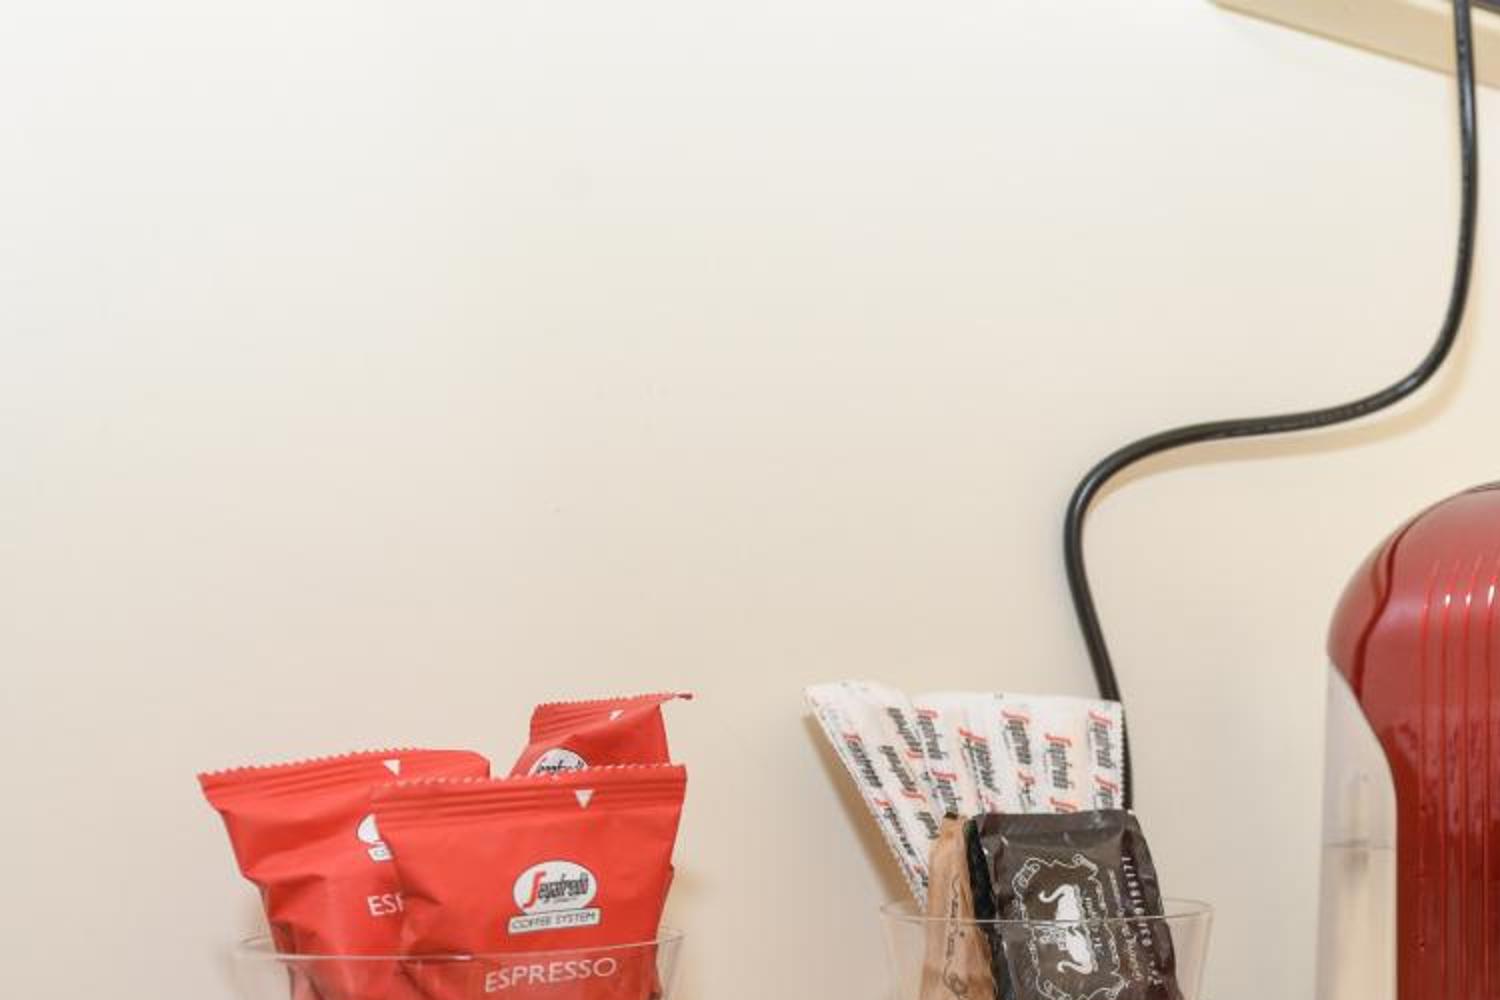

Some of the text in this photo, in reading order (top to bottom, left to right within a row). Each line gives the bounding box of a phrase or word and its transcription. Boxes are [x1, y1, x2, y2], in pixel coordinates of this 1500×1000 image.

[523, 870, 590, 909] Segafredo
[511, 911, 596, 930] COFFEE SYSTEM
[484, 957, 617, 993] ESPRESSO
